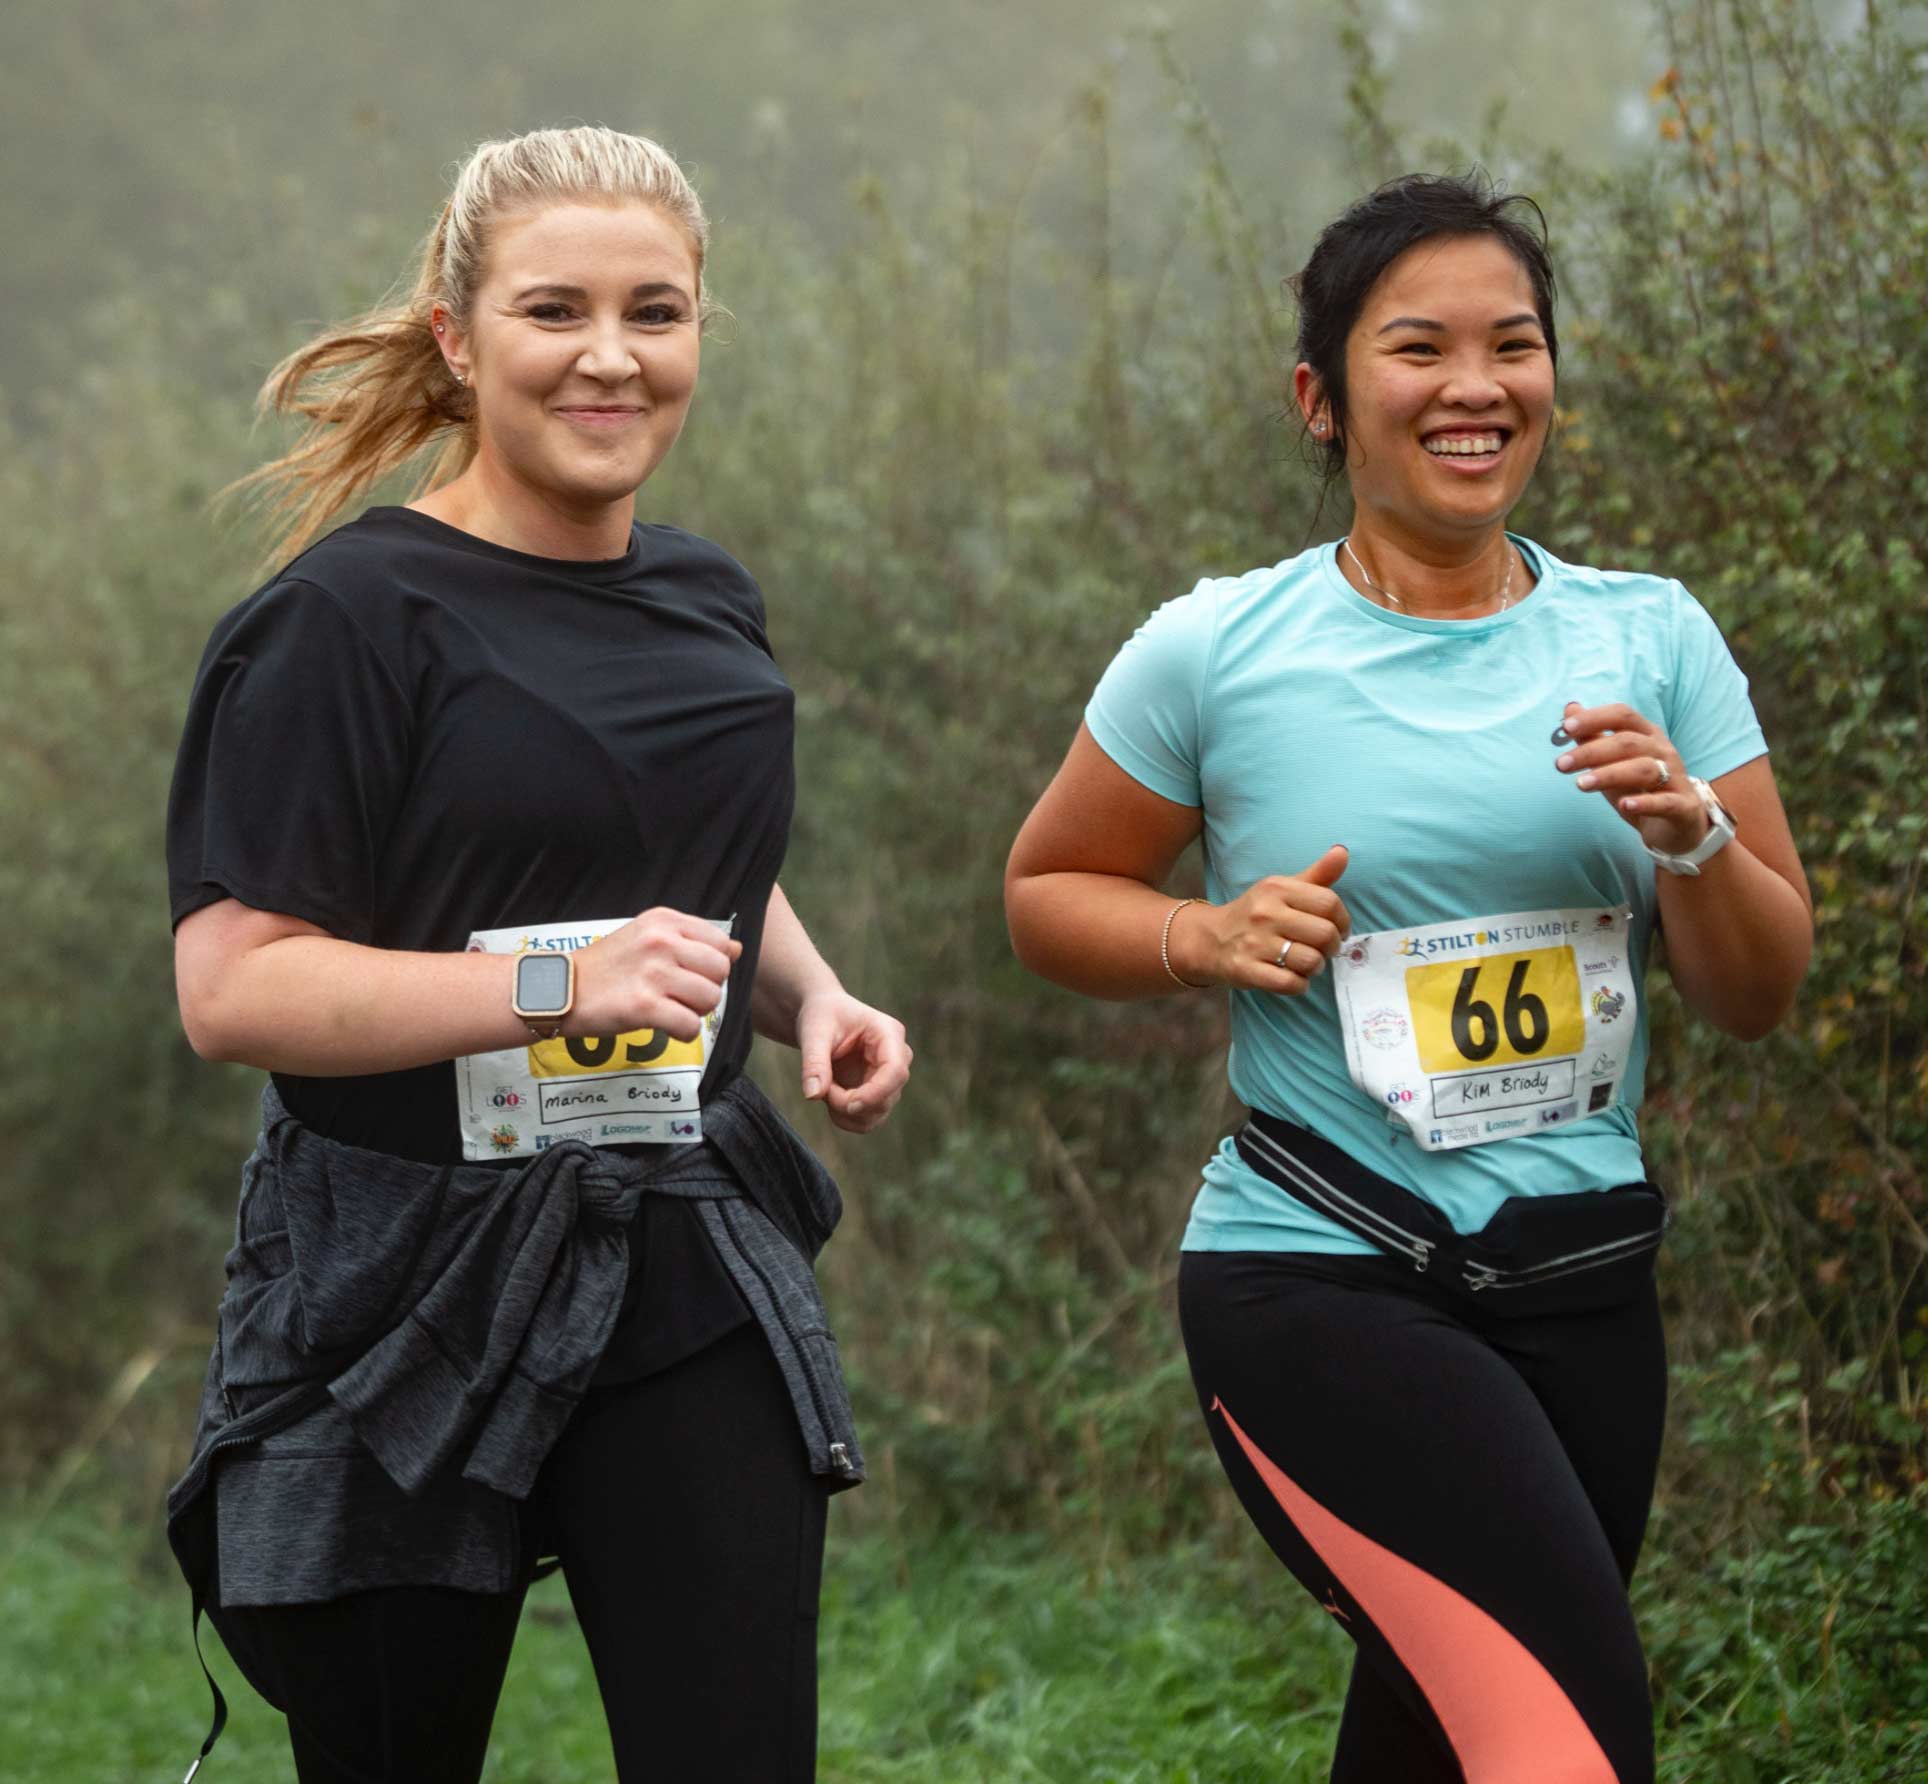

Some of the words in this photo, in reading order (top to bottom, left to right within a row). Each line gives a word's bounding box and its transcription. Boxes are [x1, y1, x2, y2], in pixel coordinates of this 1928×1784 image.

[1427, 929, 1500, 953] STILTON
[1504, 920, 1580, 943] STUMBLE
[1451, 959, 1550, 1062] 66
